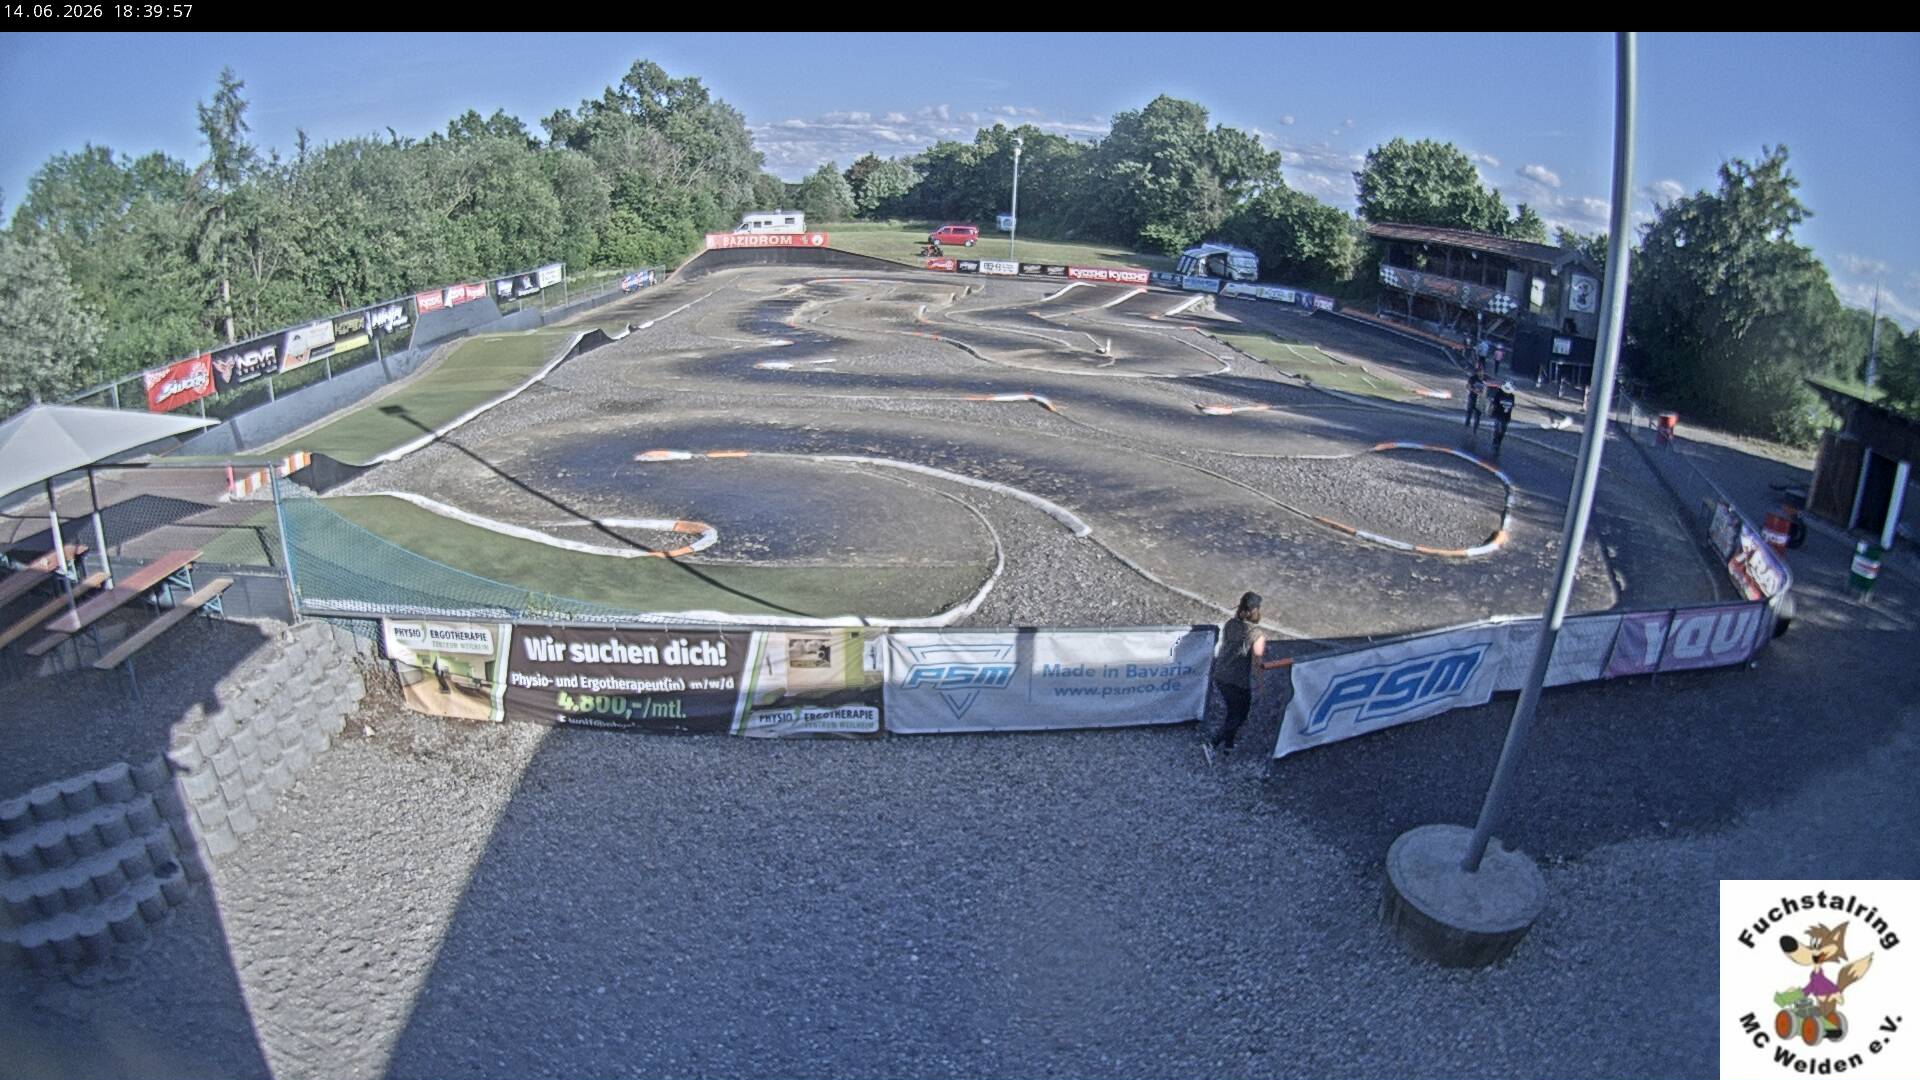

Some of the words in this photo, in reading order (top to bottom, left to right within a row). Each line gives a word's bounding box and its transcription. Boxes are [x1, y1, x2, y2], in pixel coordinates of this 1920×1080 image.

[394, 627, 421, 639] PHYSIO
[430, 629, 487, 642] ERGOTHERAPIE
[524, 635, 566, 662] Wir
[569, 637, 660, 665] suchen
[663, 638, 728, 667] dich!
[1043, 664, 1096, 678] Made
[1103, 664, 1118, 678] in
[511, 672, 554, 689] Physio-
[556, 674, 579, 689] und
[580, 675, 686, 694] Ergotherapeut(in)
[690, 677, 735, 691] m/w/d
[1054, 679, 1182, 698] www.psmco.de
[1307, 648, 1487, 731] PSM
[760, 712, 793, 723] PHYSIO
[804, 709, 874, 722] ERGOTHERAPIE
